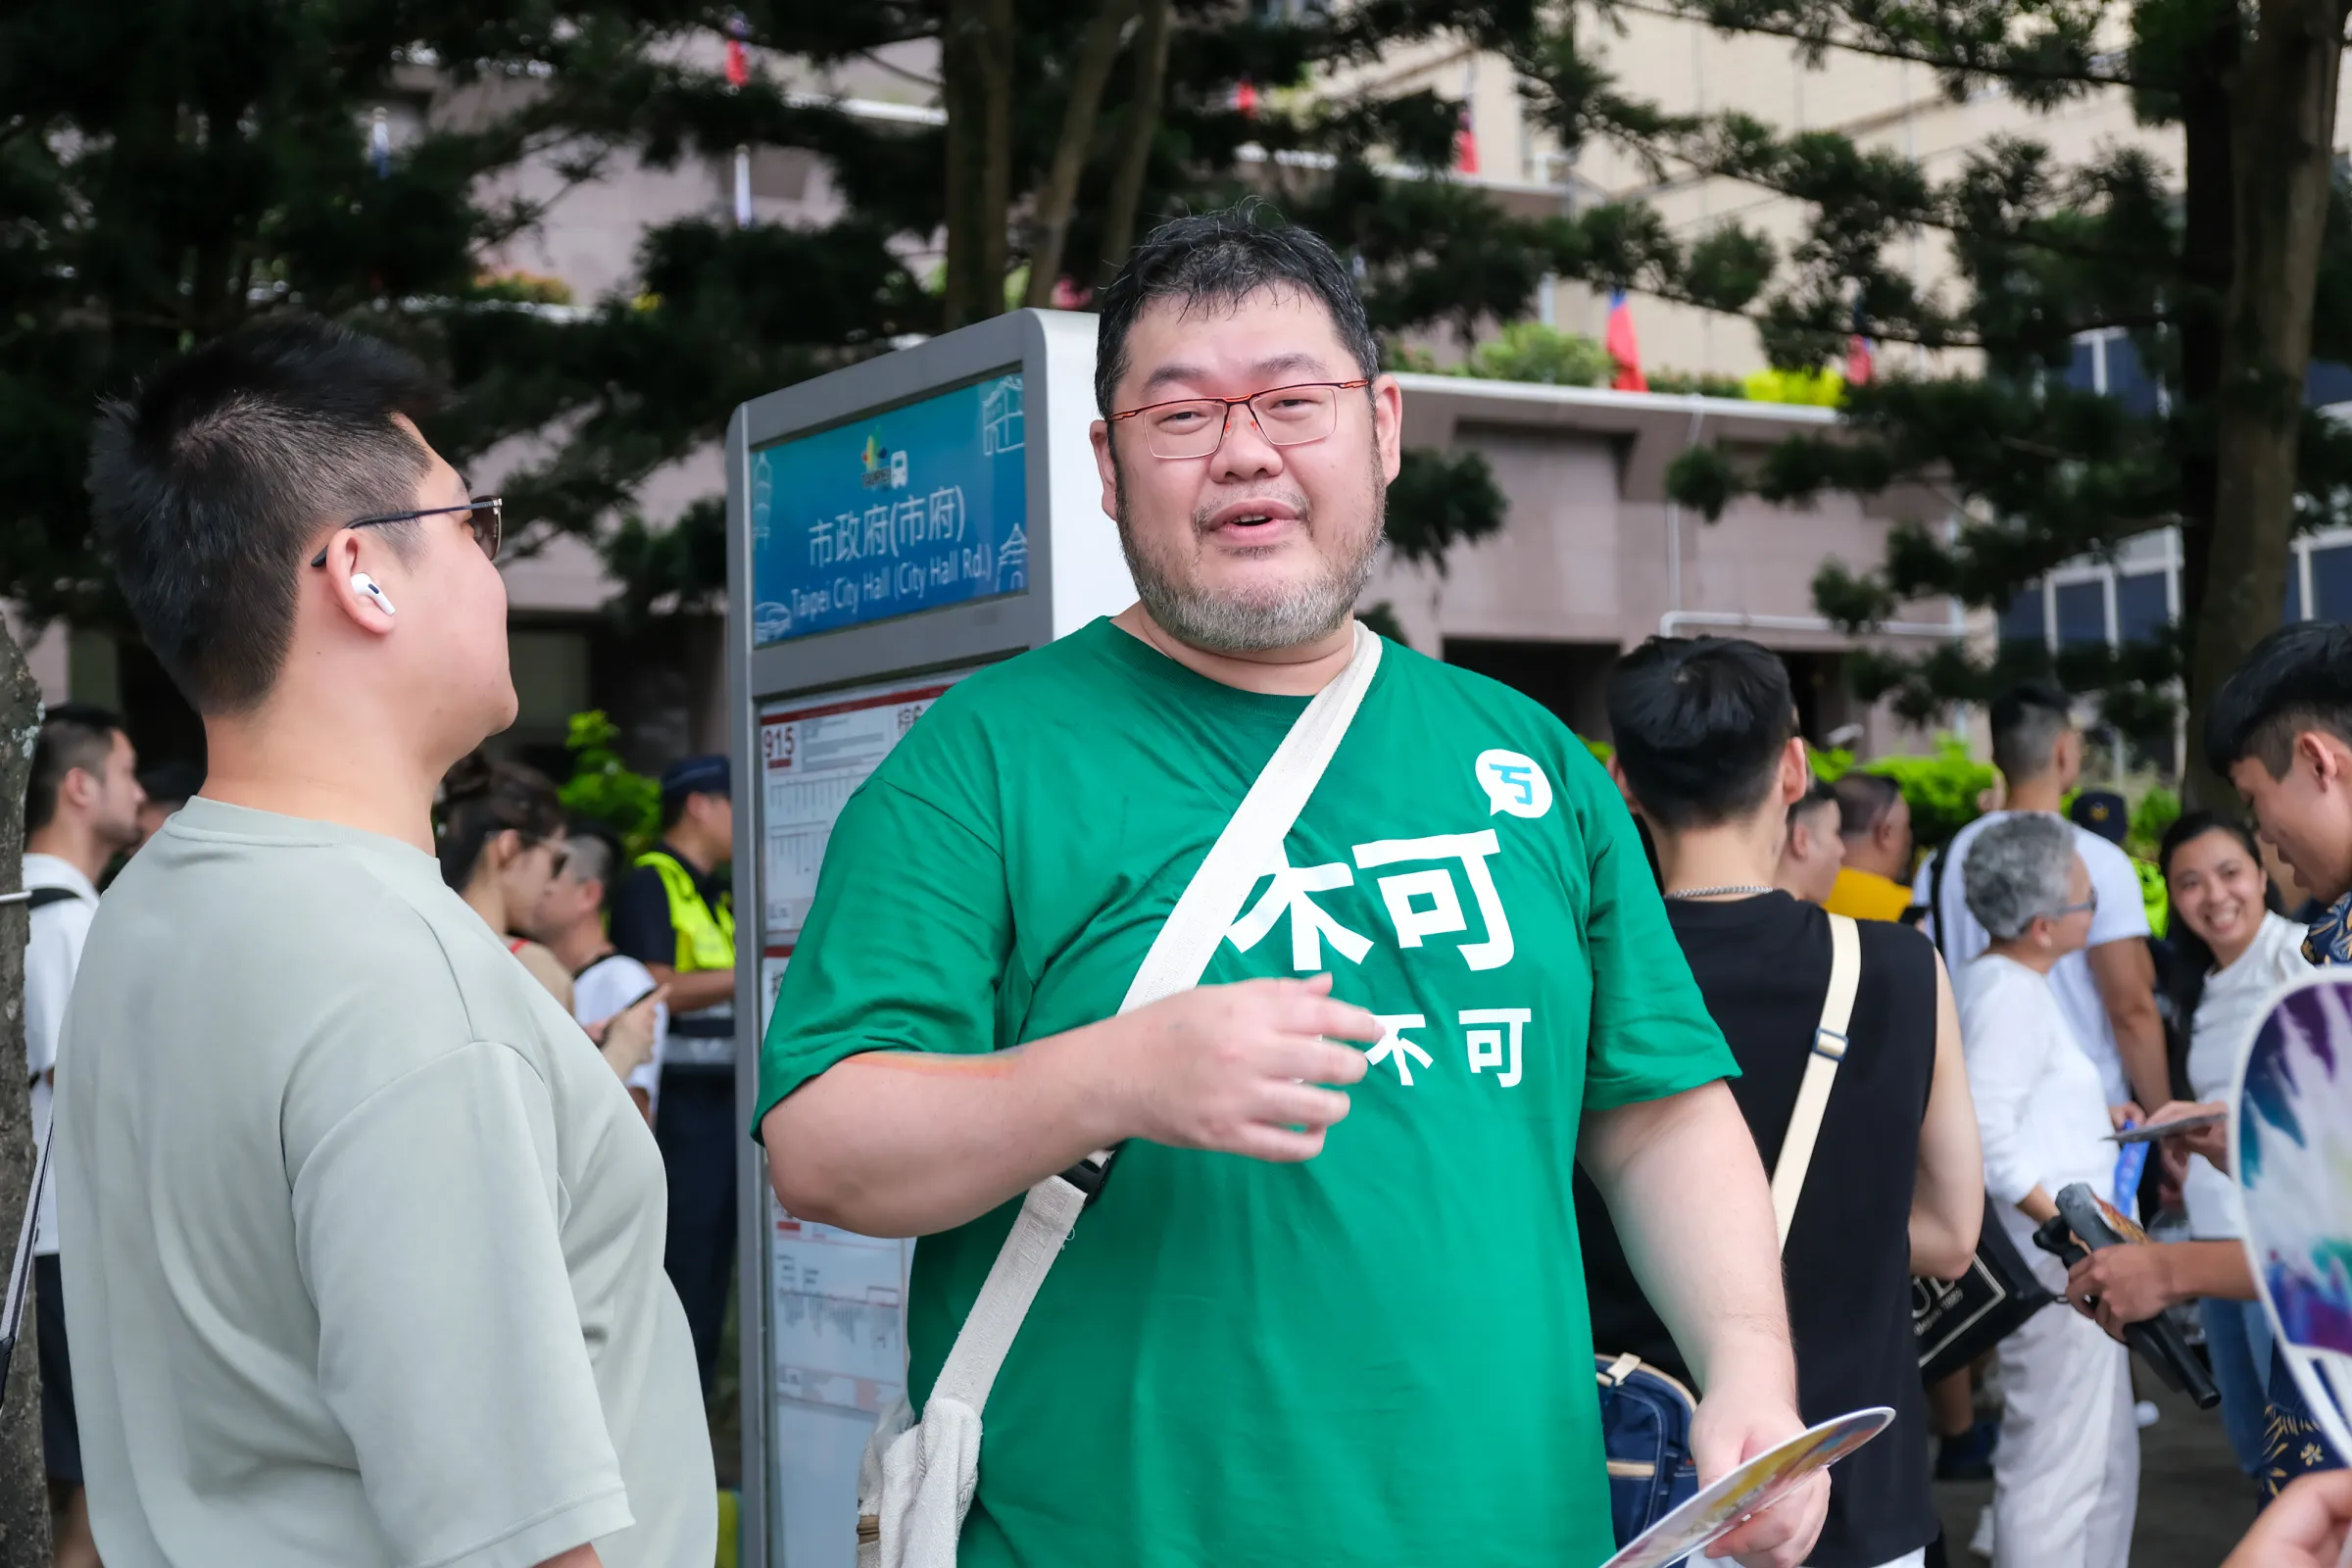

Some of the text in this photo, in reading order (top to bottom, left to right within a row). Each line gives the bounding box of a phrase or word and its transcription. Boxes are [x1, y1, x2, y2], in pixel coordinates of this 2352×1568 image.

[808, 484, 964, 568] 市政府(市府)
[790, 543, 992, 622] Taipei City Hall (City Hall Rd.)
[762, 725, 796, 759] 915
